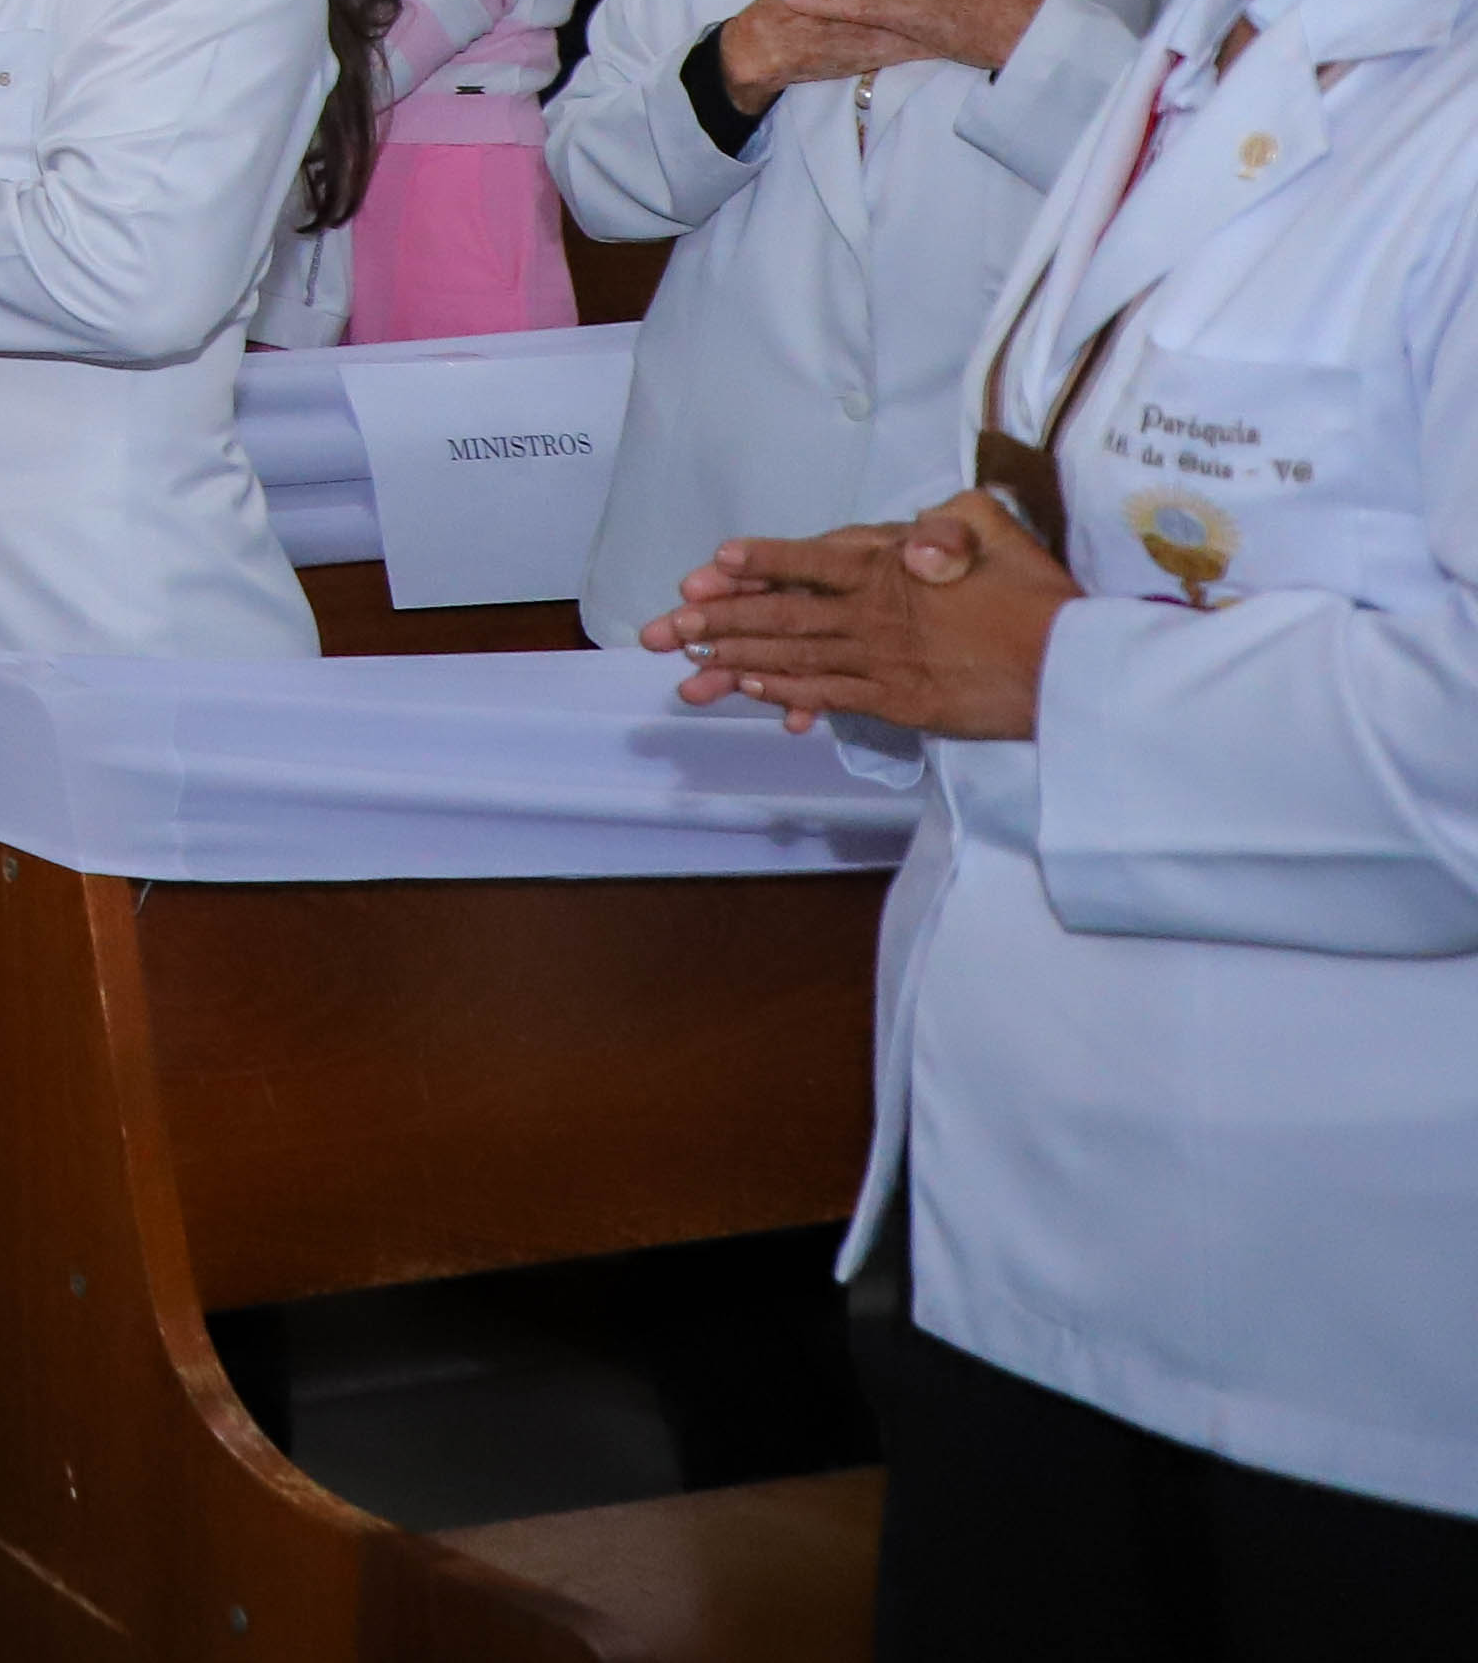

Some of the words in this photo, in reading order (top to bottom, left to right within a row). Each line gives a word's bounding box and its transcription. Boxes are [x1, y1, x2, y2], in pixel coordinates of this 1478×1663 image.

[1140, 403, 1262, 447] Paróquia
[447, 433, 594, 462] MINISTROS
[1178, 450, 1234, 480] Guia
